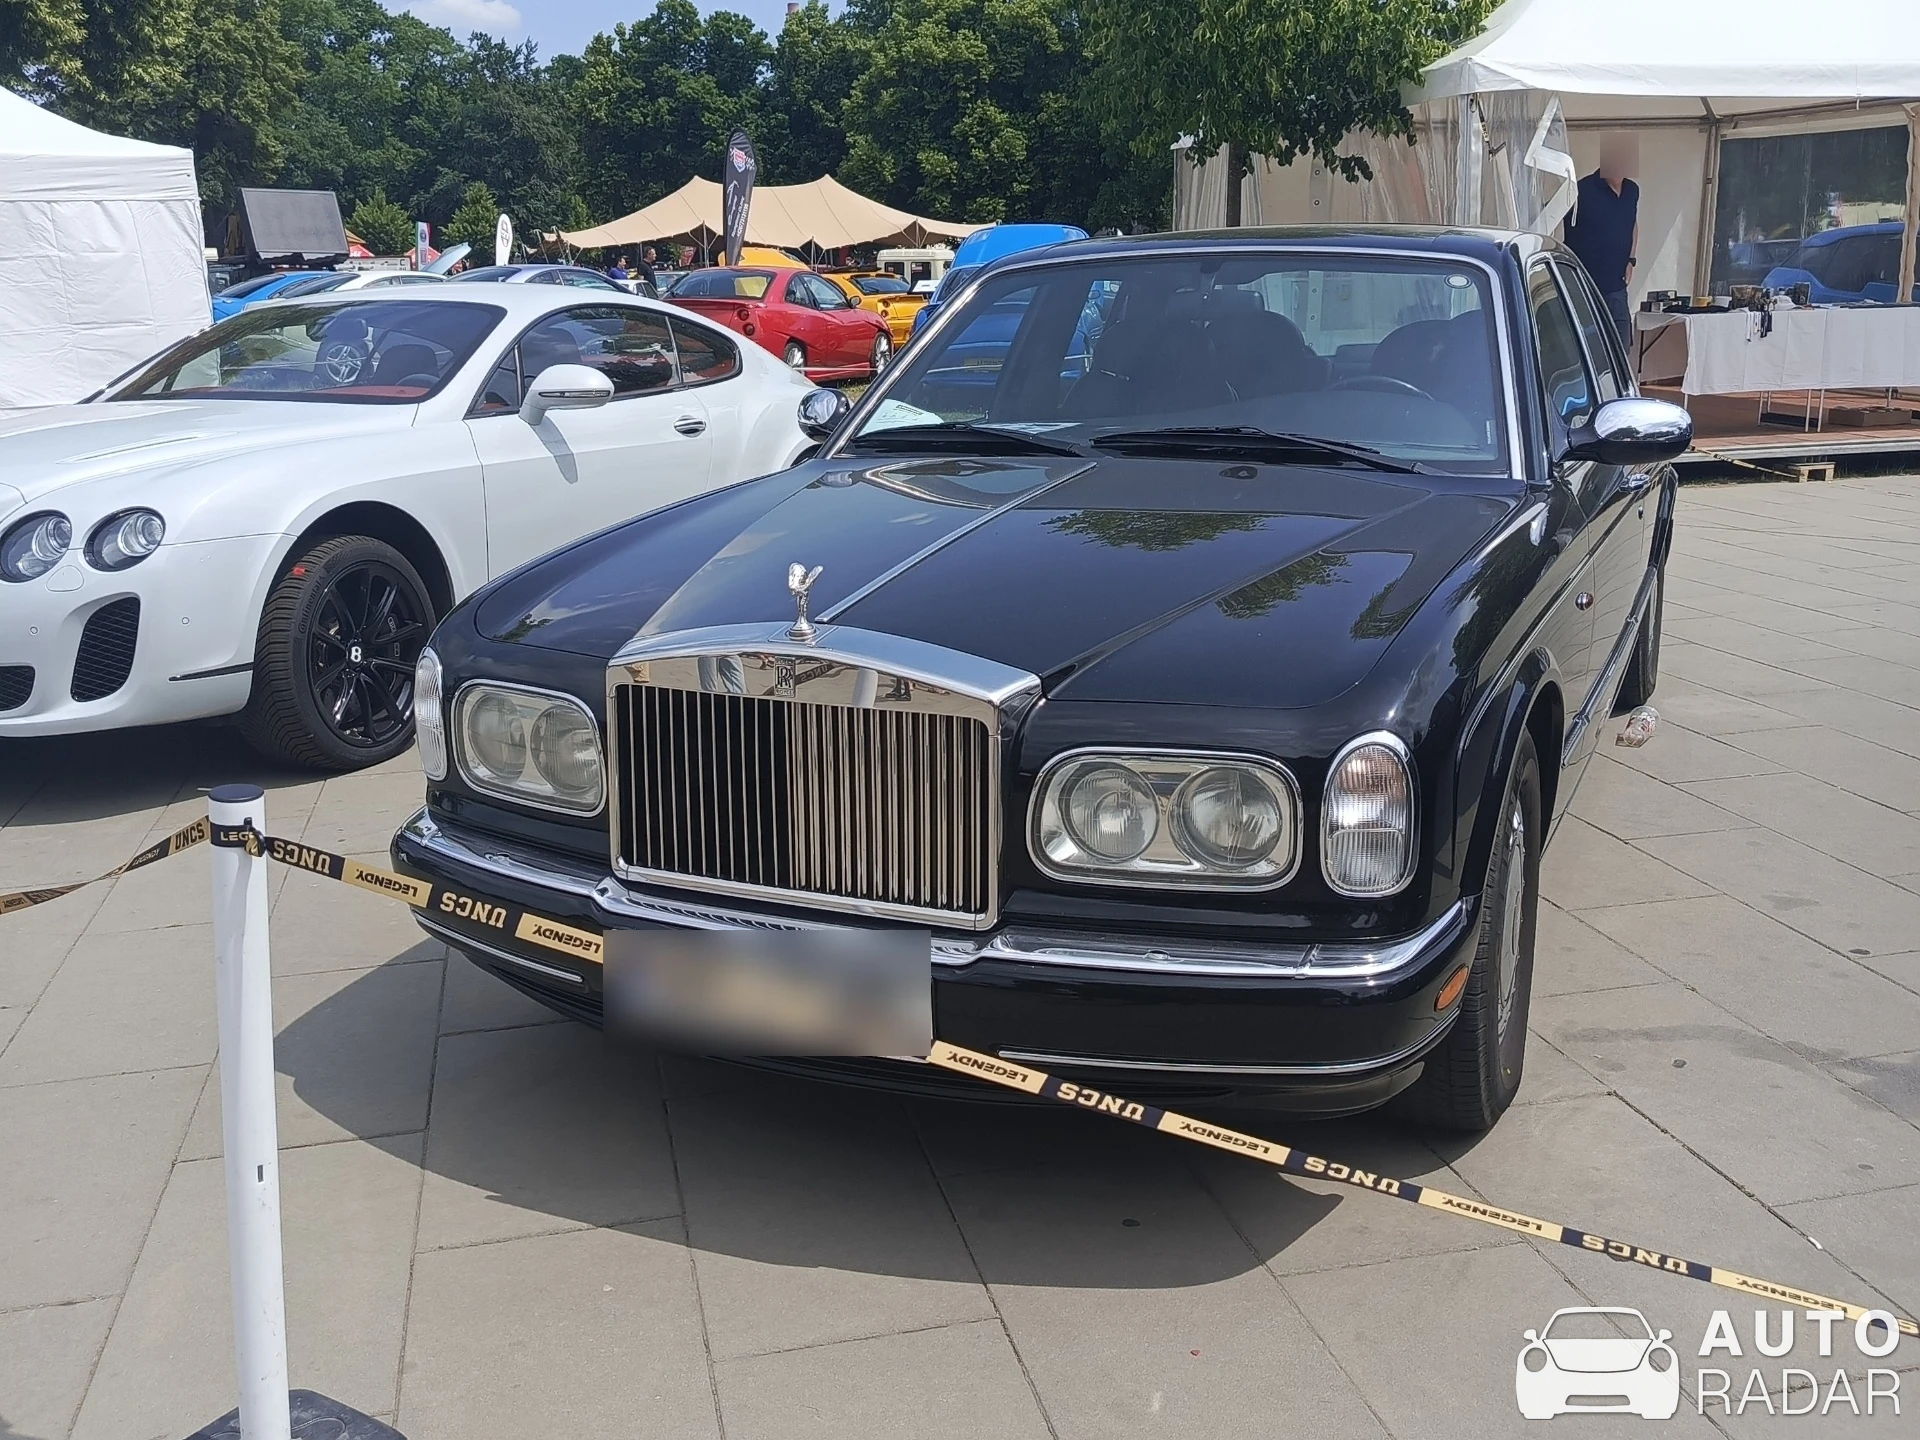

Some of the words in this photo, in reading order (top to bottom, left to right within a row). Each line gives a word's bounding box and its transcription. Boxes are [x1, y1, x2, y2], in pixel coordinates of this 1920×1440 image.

[350, 646, 362, 662] B
[175, 823, 205, 850] UNCS
[273, 840, 331, 874] UNCS
[440, 891, 507, 929] UNCS
[1057, 1083, 1145, 1121] UNCS
[1304, 1156, 1400, 1194] UNCS
[1582, 1234, 1689, 1275] UNCS
